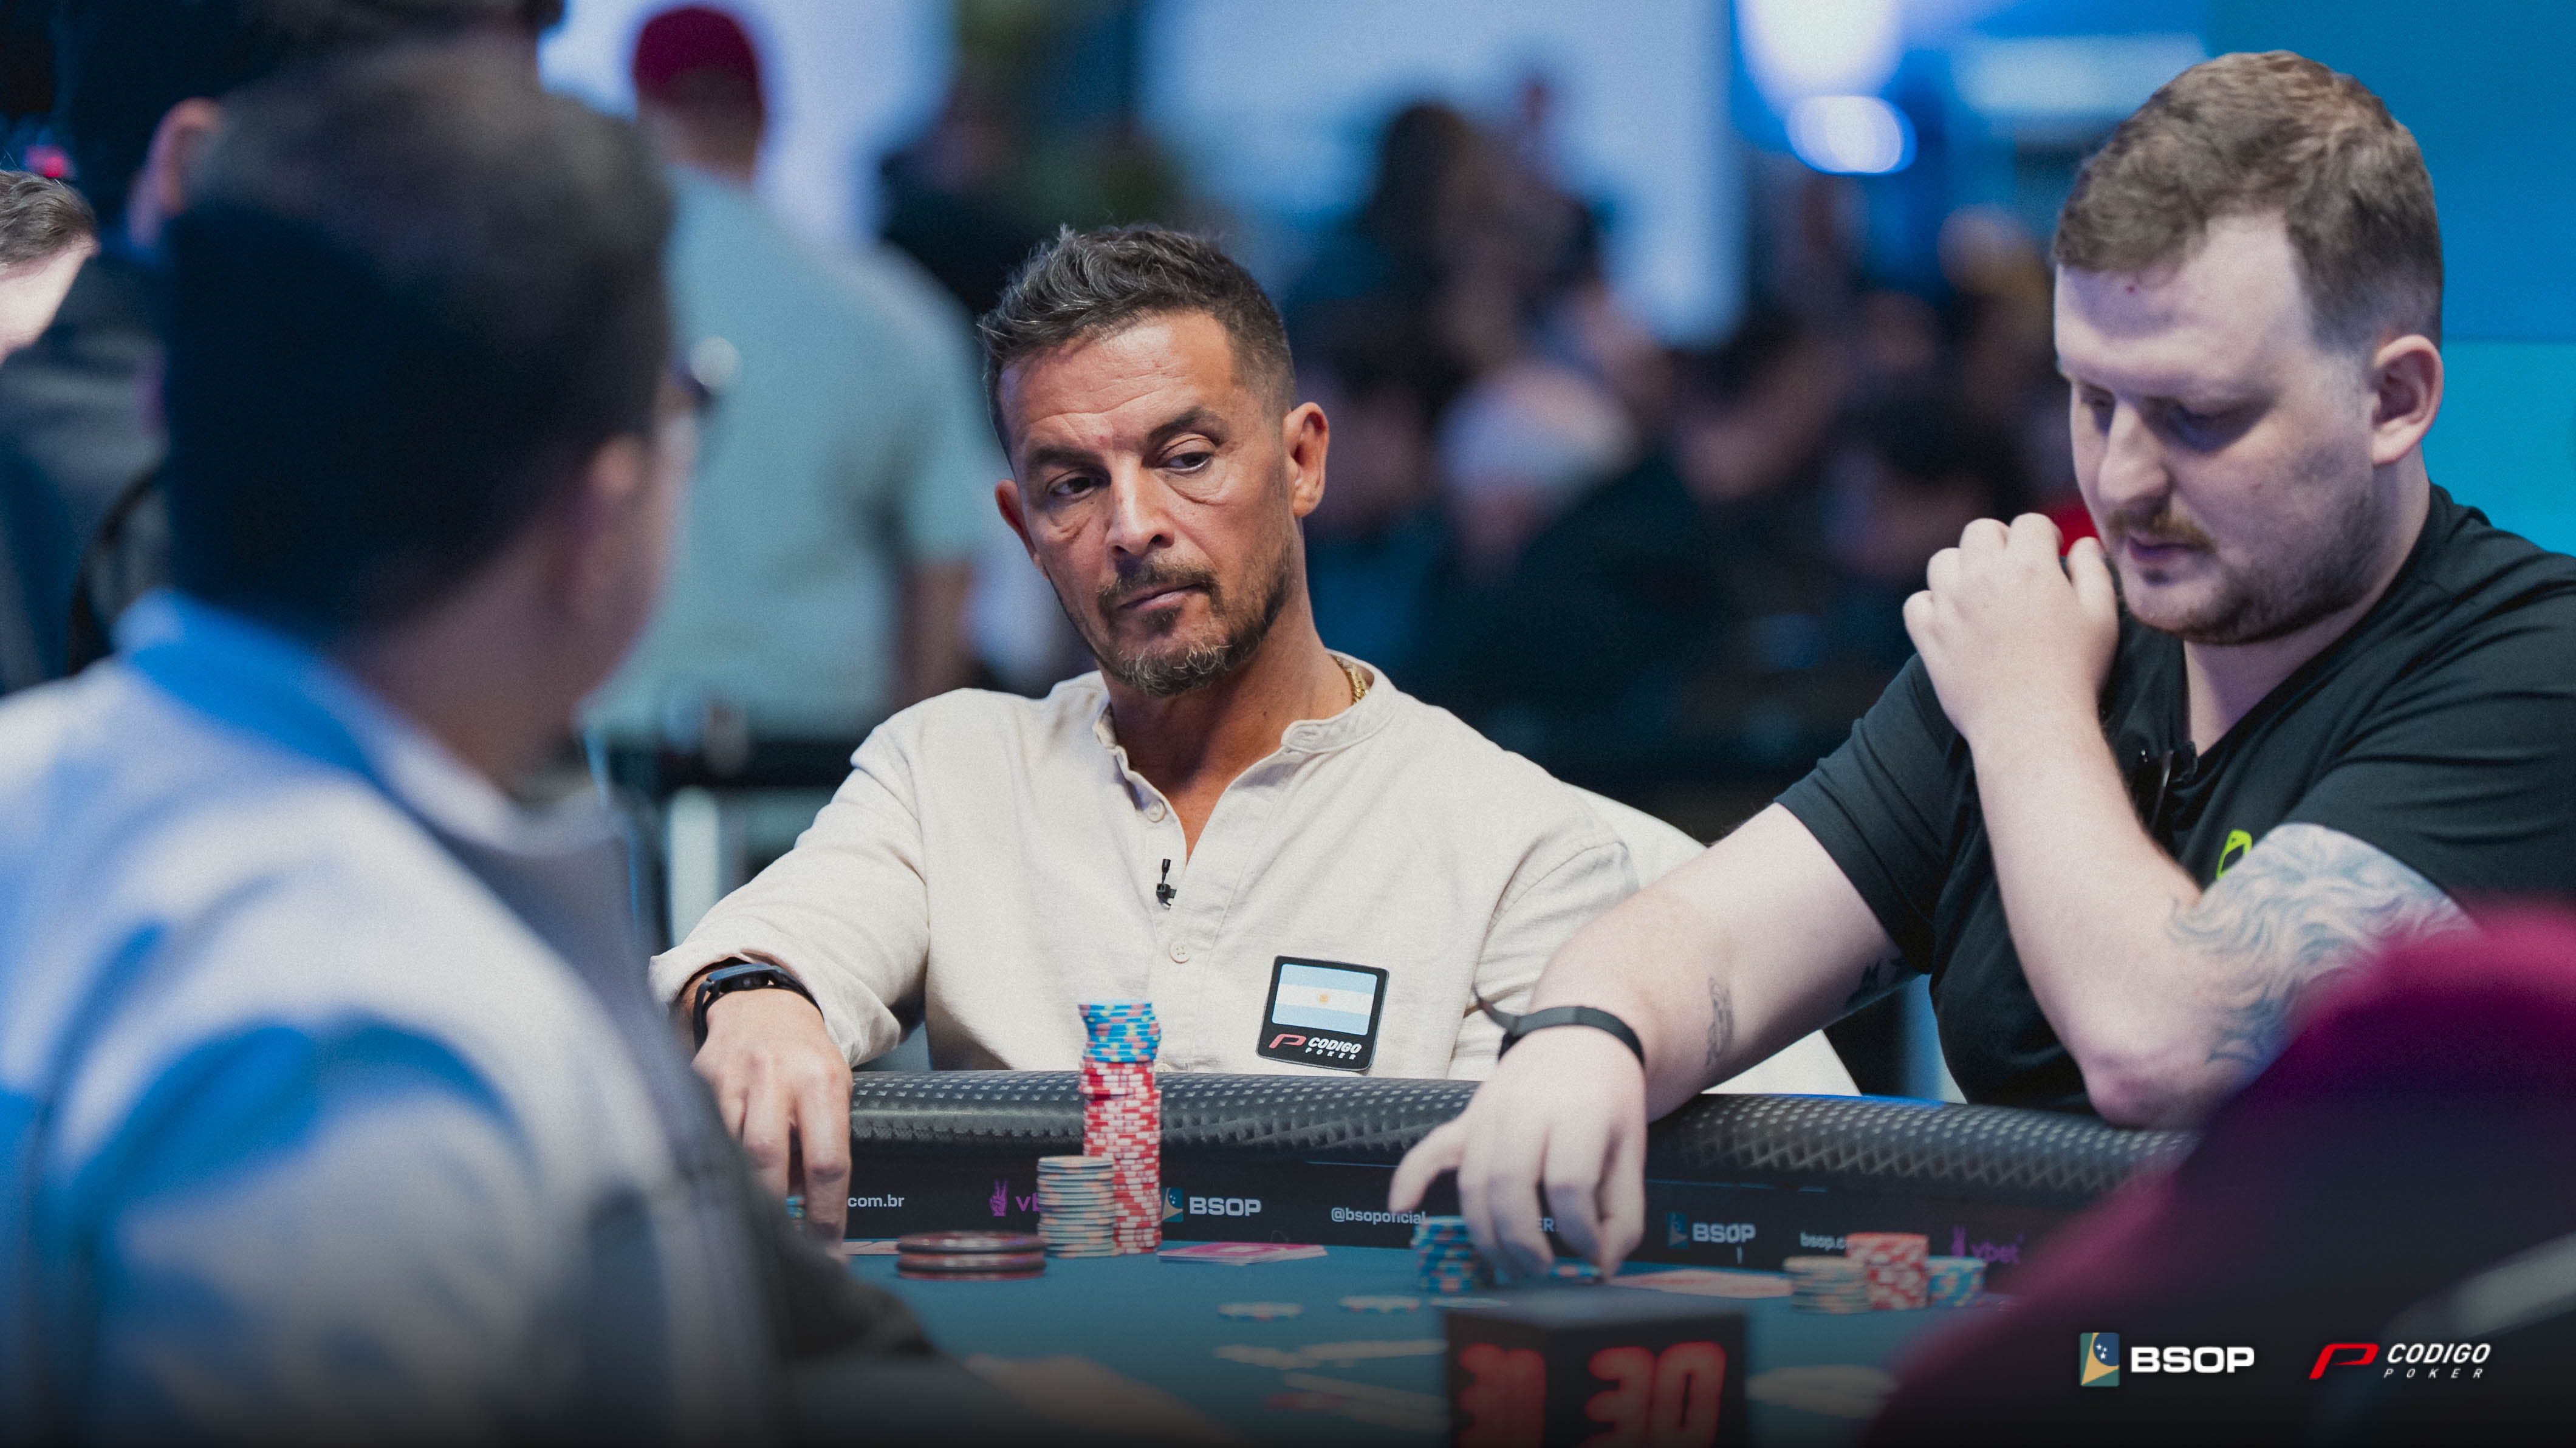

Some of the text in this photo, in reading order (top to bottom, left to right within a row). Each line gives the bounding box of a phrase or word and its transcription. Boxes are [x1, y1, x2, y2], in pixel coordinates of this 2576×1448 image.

[1305, 1047, 1357, 1060] POKER
[1308, 1037, 1362, 1054] CODIGO
[847, 1194, 905, 1207] com.br
[1189, 1197, 1262, 1217] BSOP
[1692, 1223, 1756, 1243] BSOP
[1580, 1341, 1727, 1448] 30
